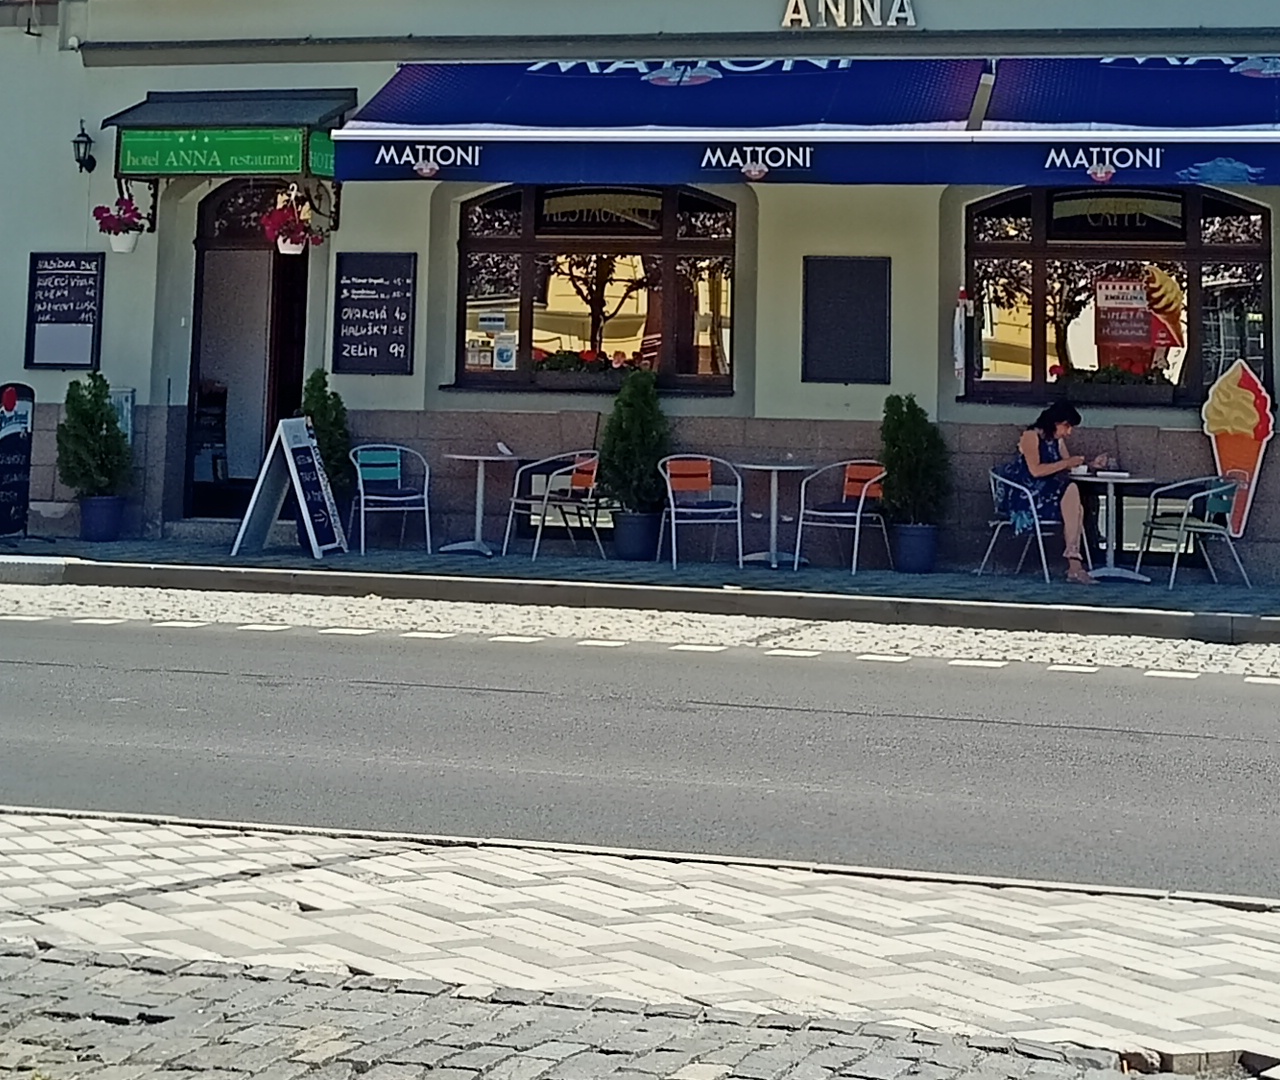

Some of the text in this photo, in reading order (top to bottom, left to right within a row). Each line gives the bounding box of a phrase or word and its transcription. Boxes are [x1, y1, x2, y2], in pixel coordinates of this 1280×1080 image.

[126, 150, 295, 167] hotel ANNA restaurant
[375, 144, 480, 167] MATTONI
[701, 145, 811, 169] MATTONI
[1044, 147, 1163, 170] MATTONI
[341, 322, 388, 337] HALUŠKY
[389, 342, 406, 359] 99
